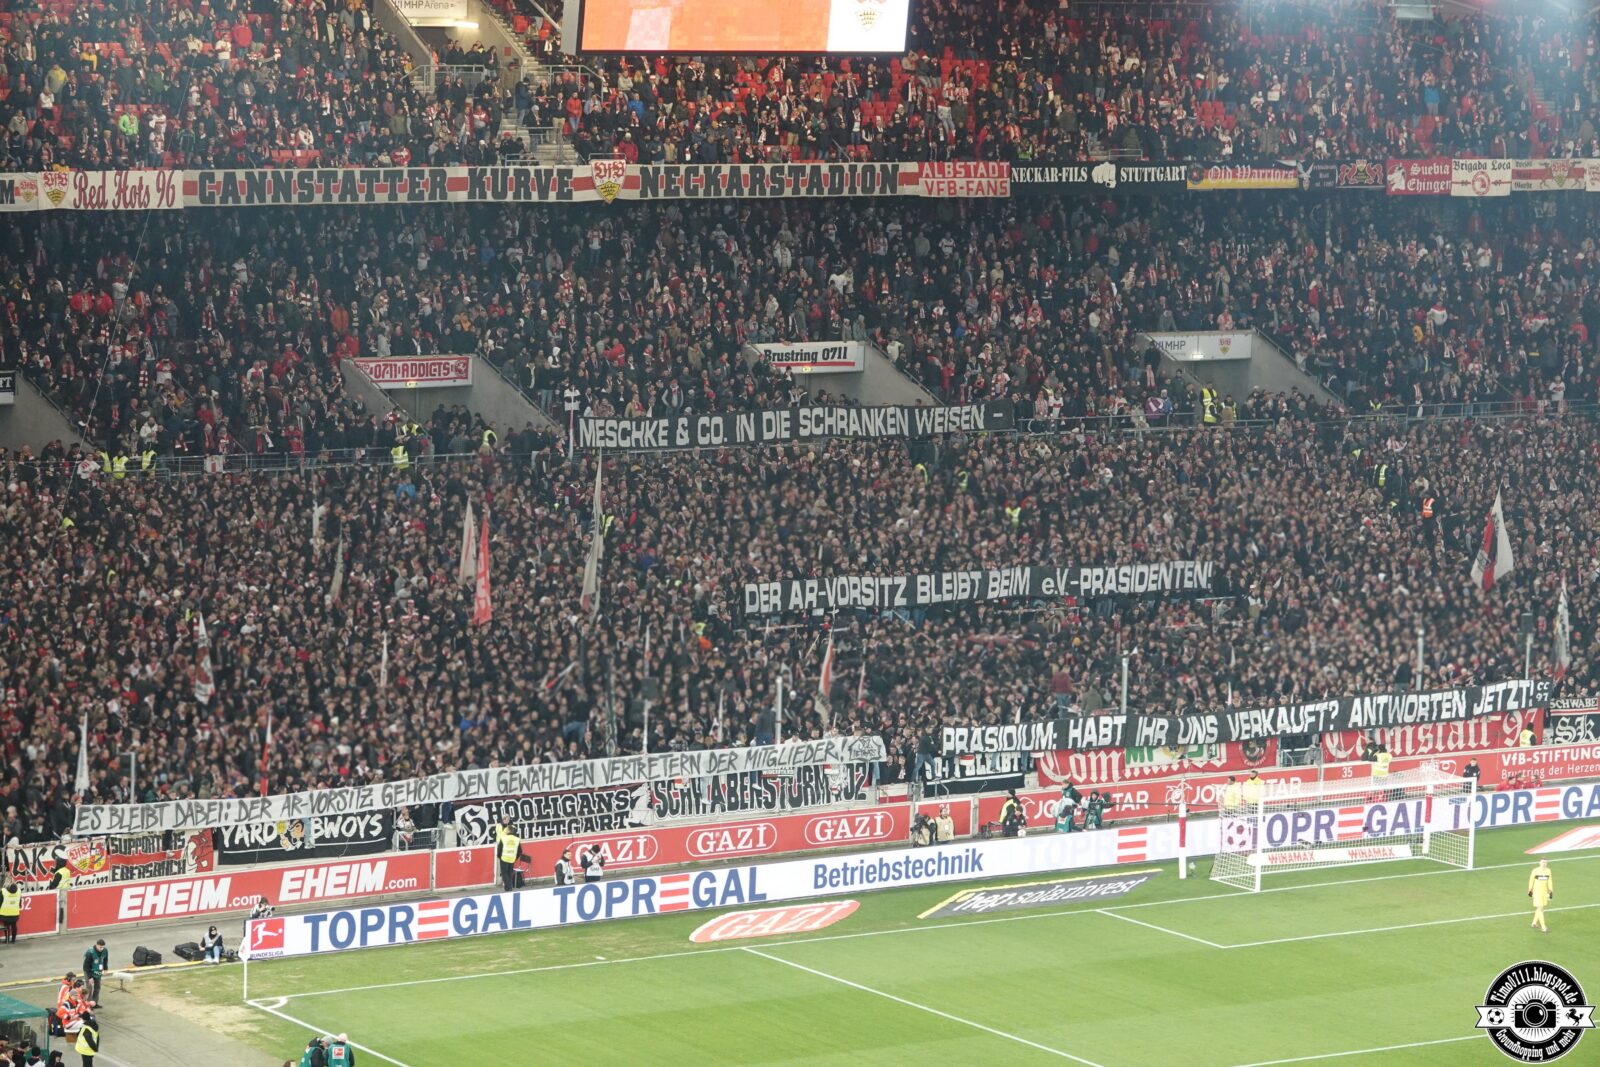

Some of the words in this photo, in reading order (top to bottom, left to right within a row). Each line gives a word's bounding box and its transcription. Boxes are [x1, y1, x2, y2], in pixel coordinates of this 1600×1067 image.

[921, 162, 1009, 178] ALBSTADT
[1011, 166, 1088, 183] NECKAR-FILS
[1120, 165, 1187, 182] STUTTGART
[1208, 165, 1232, 183] Old
[1235, 165, 1295, 184] Warriors
[1410, 163, 1450, 175] Suebia
[1453, 160, 1488, 173] Brigada
[1491, 160, 1511, 170] Loca
[73, 170, 109, 209] Red
[113, 170, 151, 209] Hots
[156, 169, 176, 208] 96
[199, 169, 448, 205] CANNSTATTER
[467, 167, 573, 201] KURVE
[639, 163, 900, 198] NECKARSTADION
[924, 180, 1009, 196] VFB-FANS
[1165, 341, 1186, 350] MHP
[764, 348, 818, 364] Brustring
[822, 346, 848, 360] 0711
[402, 362, 450, 378] ADDICTS
[579, 417, 669, 448] MESCHKE
[676, 417, 690, 446] &
[698, 416, 728, 444] CO.
[736, 413, 755, 442] IN
[762, 411, 791, 440] DIE
[799, 406, 910, 437] SCHRANKEN
[915, 404, 985, 435] WEISEN
[745, 581, 782, 614] DER
[788, 576, 907, 611] AR-VORSITZ
[917, 571, 981, 604] BLEIBT
[986, 566, 1031, 600] BEIM
[1536, 681, 1550, 691] CC
[1536, 693, 1549, 701] 97
[942, 721, 1058, 756] PRÄSIDIUM:
[1068, 715, 1126, 749] HABT
[1135, 716, 1169, 746] IHR
[1177, 714, 1218, 745] UNS
[1226, 700, 1340, 742] VERKAUFT?
[1348, 689, 1467, 728] ANTWORTEN
[1473, 679, 1534, 716] JETZT!
[1501, 746, 1600, 768] VfB-STIFTUNG
[1342, 766, 1353, 778] 35
[1548, 764, 1564, 776] der
[76, 805, 104, 832] ES
[107, 803, 170, 831] BLEIBT
[173, 801, 231, 828] DABEI:
[234, 797, 272, 823] DER
[279, 786, 374, 818] AR-VORSITZ
[381, 775, 450, 808] GEHÖRT
[454, 770, 489, 799] DEN
[496, 761, 596, 795] GEWÄHLTEN
[600, 752, 701, 785] VERTRETERN
[706, 751, 739, 775] DER
[484, 788, 631, 825] HOOLIGANS
[222, 820, 278, 848] YARD
[310, 814, 384, 840] BWOYS
[486, 811, 629, 842] SUTTGART
[110, 831, 186, 856] SUPPORTRS
[458, 850, 472, 864] 33
[1267, 851, 1316, 865] WINAMAX
[1347, 846, 1395, 860] WINAMAX
[813, 847, 984, 890] Betriebstechnik
[249, 950, 284, 959] BUNDESLIGA
